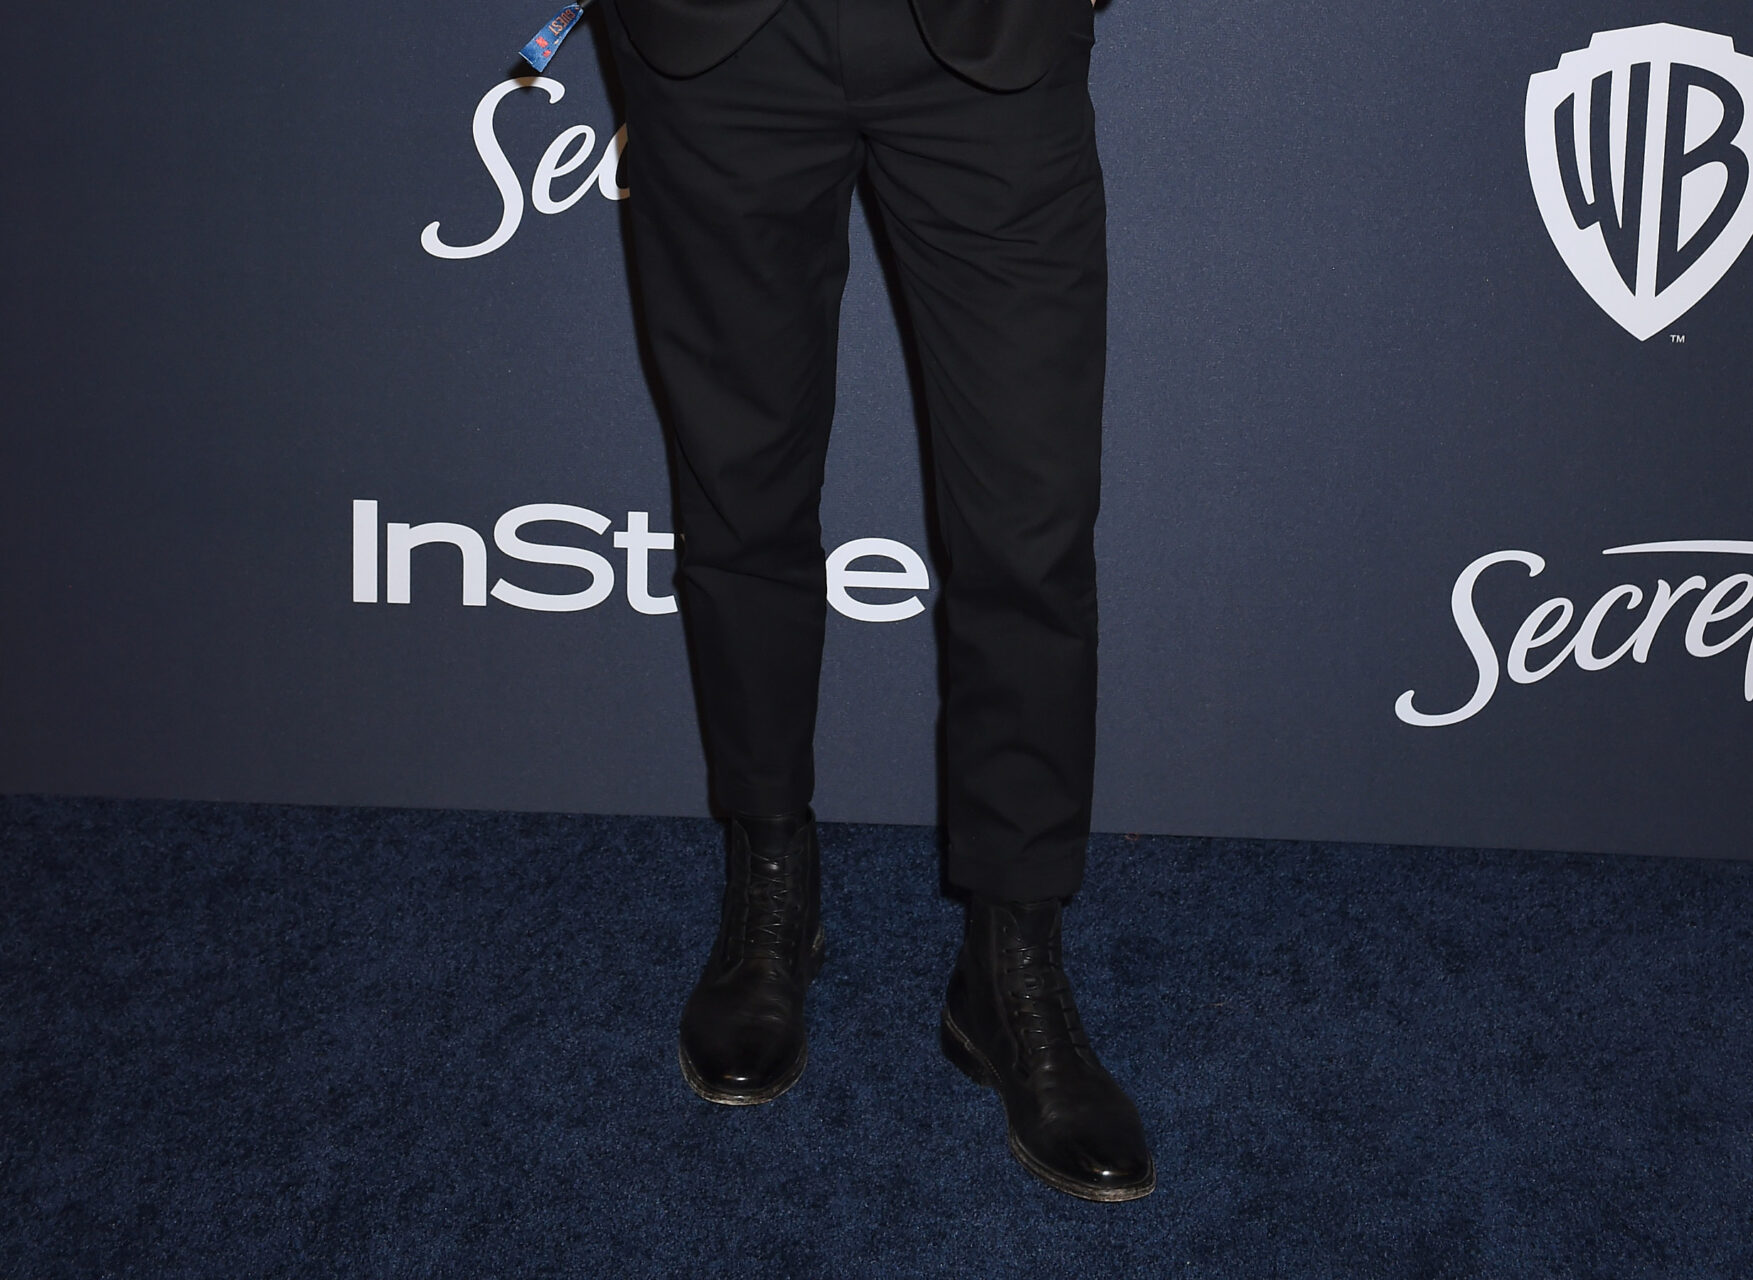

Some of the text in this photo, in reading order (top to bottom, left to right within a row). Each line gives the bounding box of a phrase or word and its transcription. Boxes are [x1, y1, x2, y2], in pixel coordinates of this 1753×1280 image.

[549, 10, 576, 36] GUEST
[1554, 60, 1751, 298] WB
[352, 499, 930, 623] InSte
[1394, 540, 1753, 727] Secre
